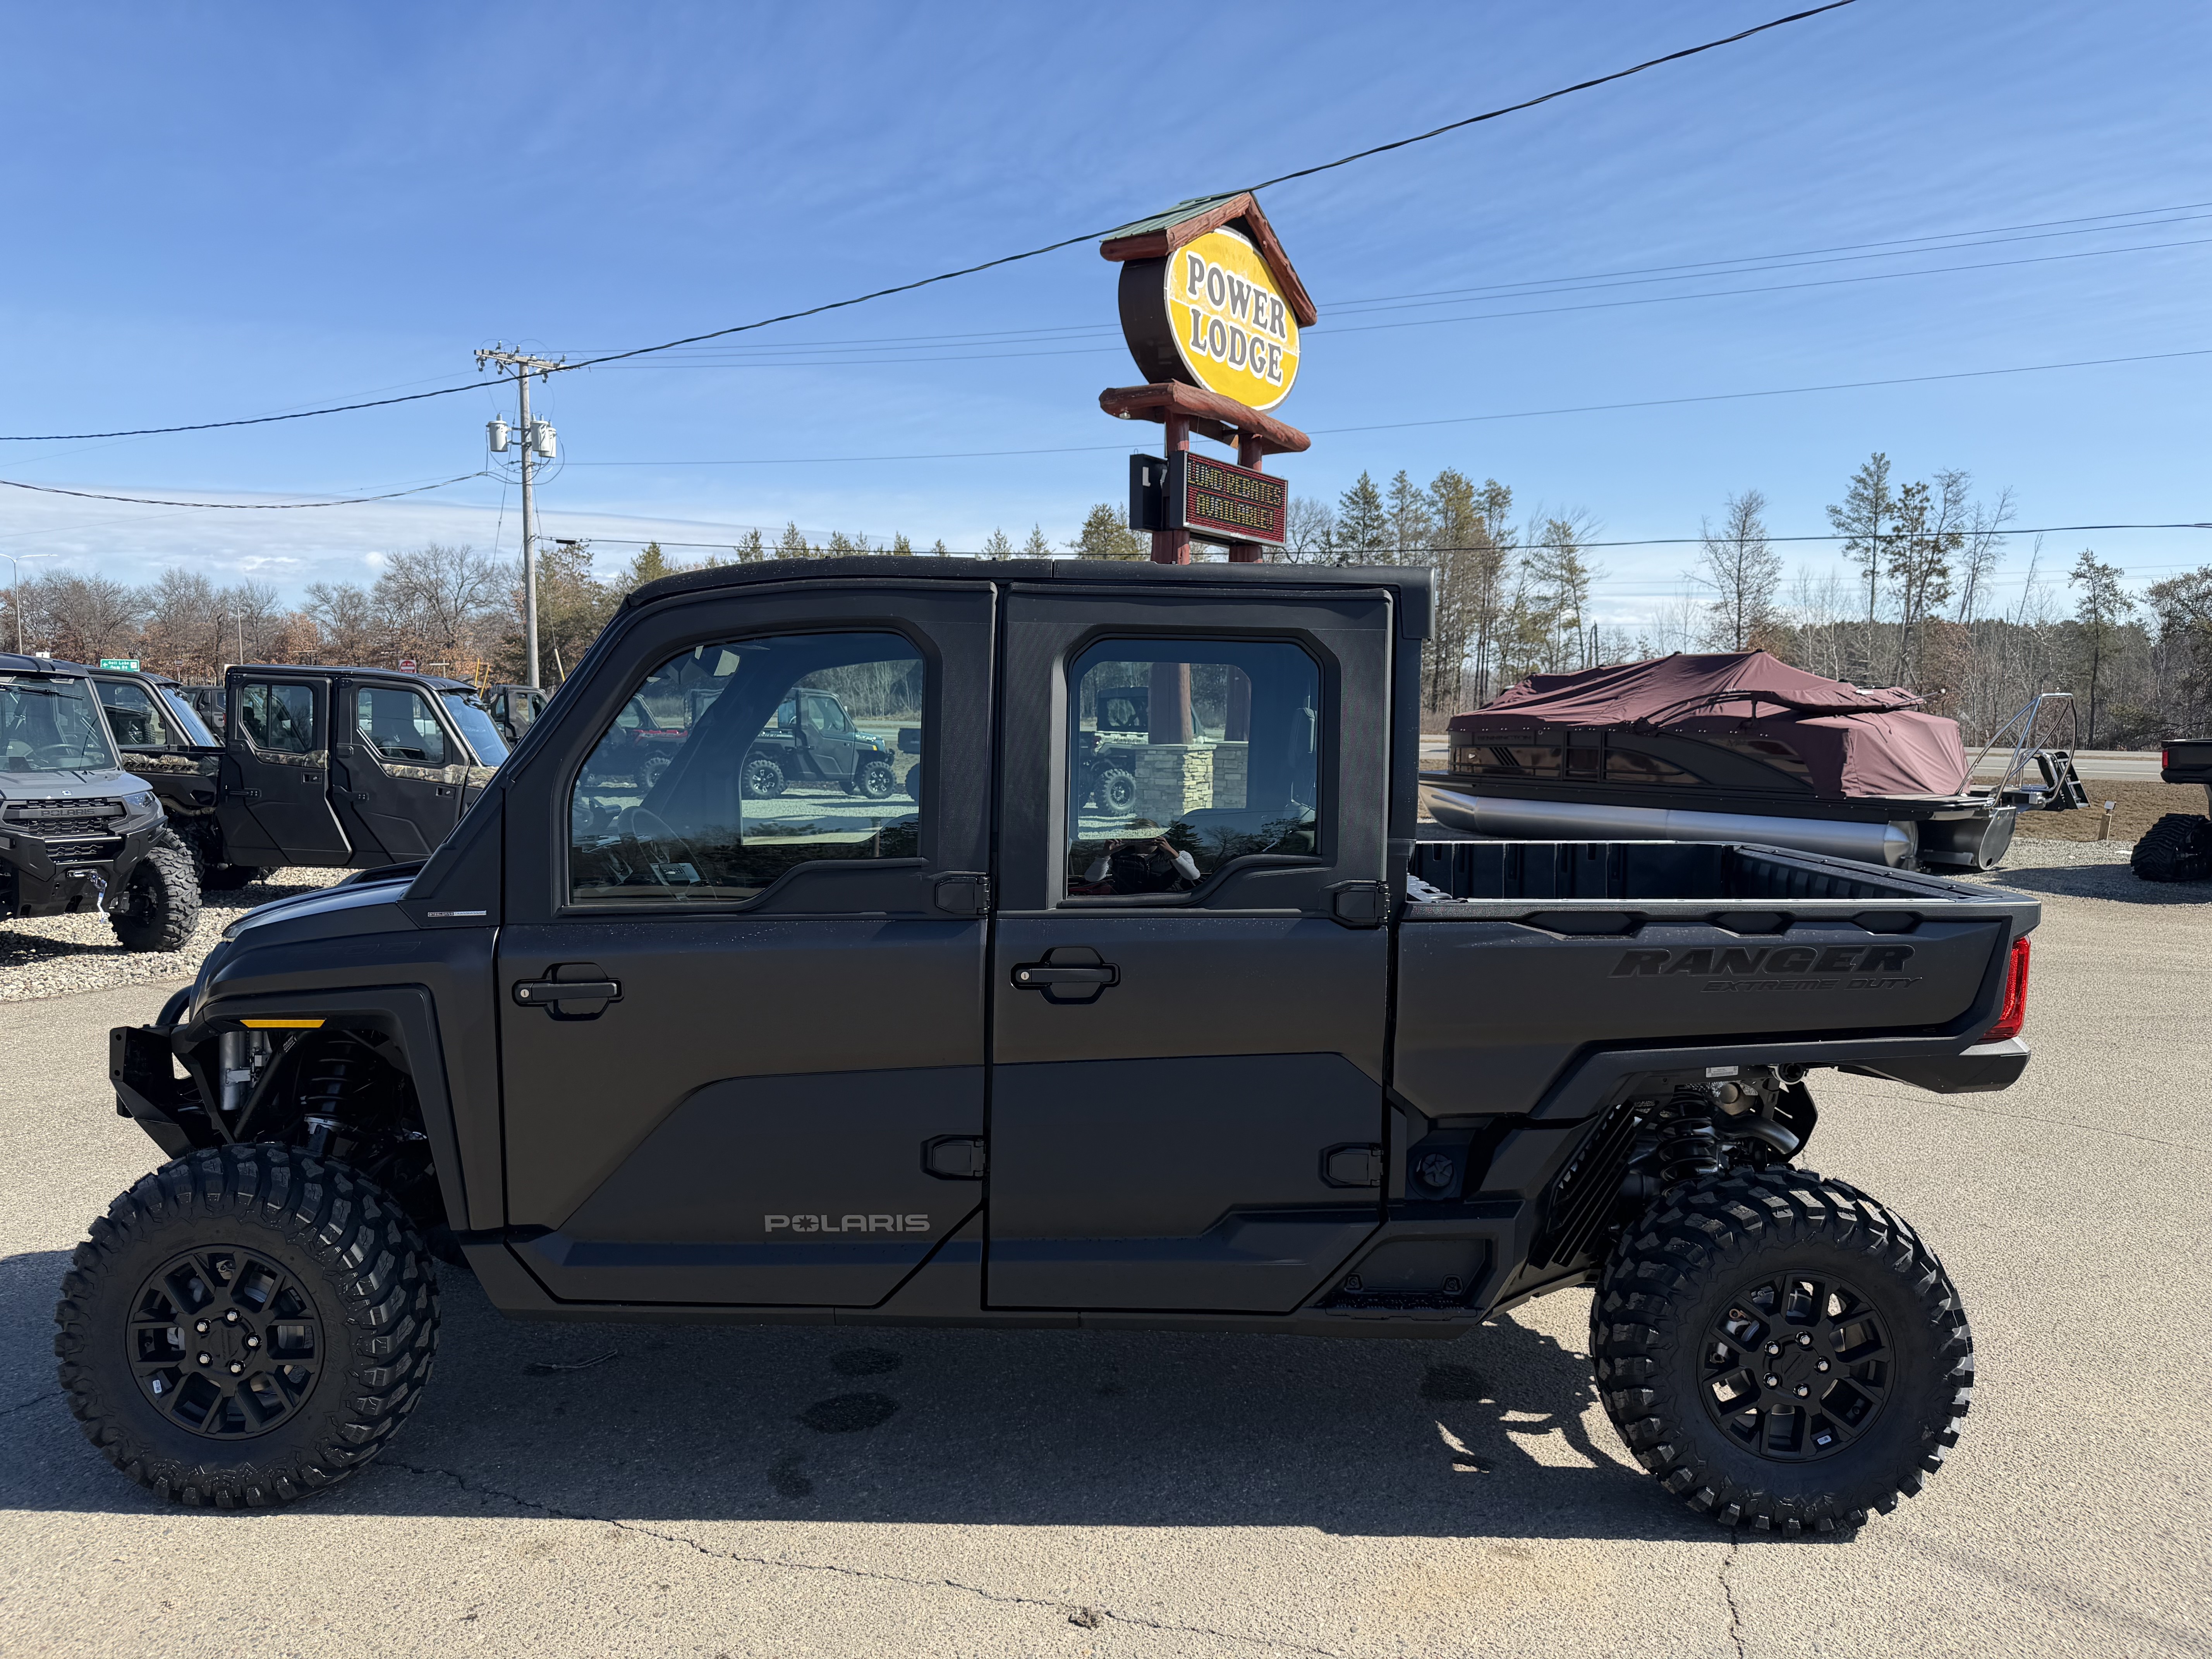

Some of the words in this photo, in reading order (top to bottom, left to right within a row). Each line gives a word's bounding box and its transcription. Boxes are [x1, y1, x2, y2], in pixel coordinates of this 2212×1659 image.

[1187, 252, 1286, 338] POWER
[1190, 308, 1283, 383] LODGE
[1226, 473, 1281, 506] REBATES
[123, 761, 194, 771] RANGER
[1607, 945, 1915, 978] RANGER
[1702, 979, 1841, 992] EXTREME
[1844, 977, 1922, 990] DUTY
[764, 1214, 930, 1232] POLARIS
